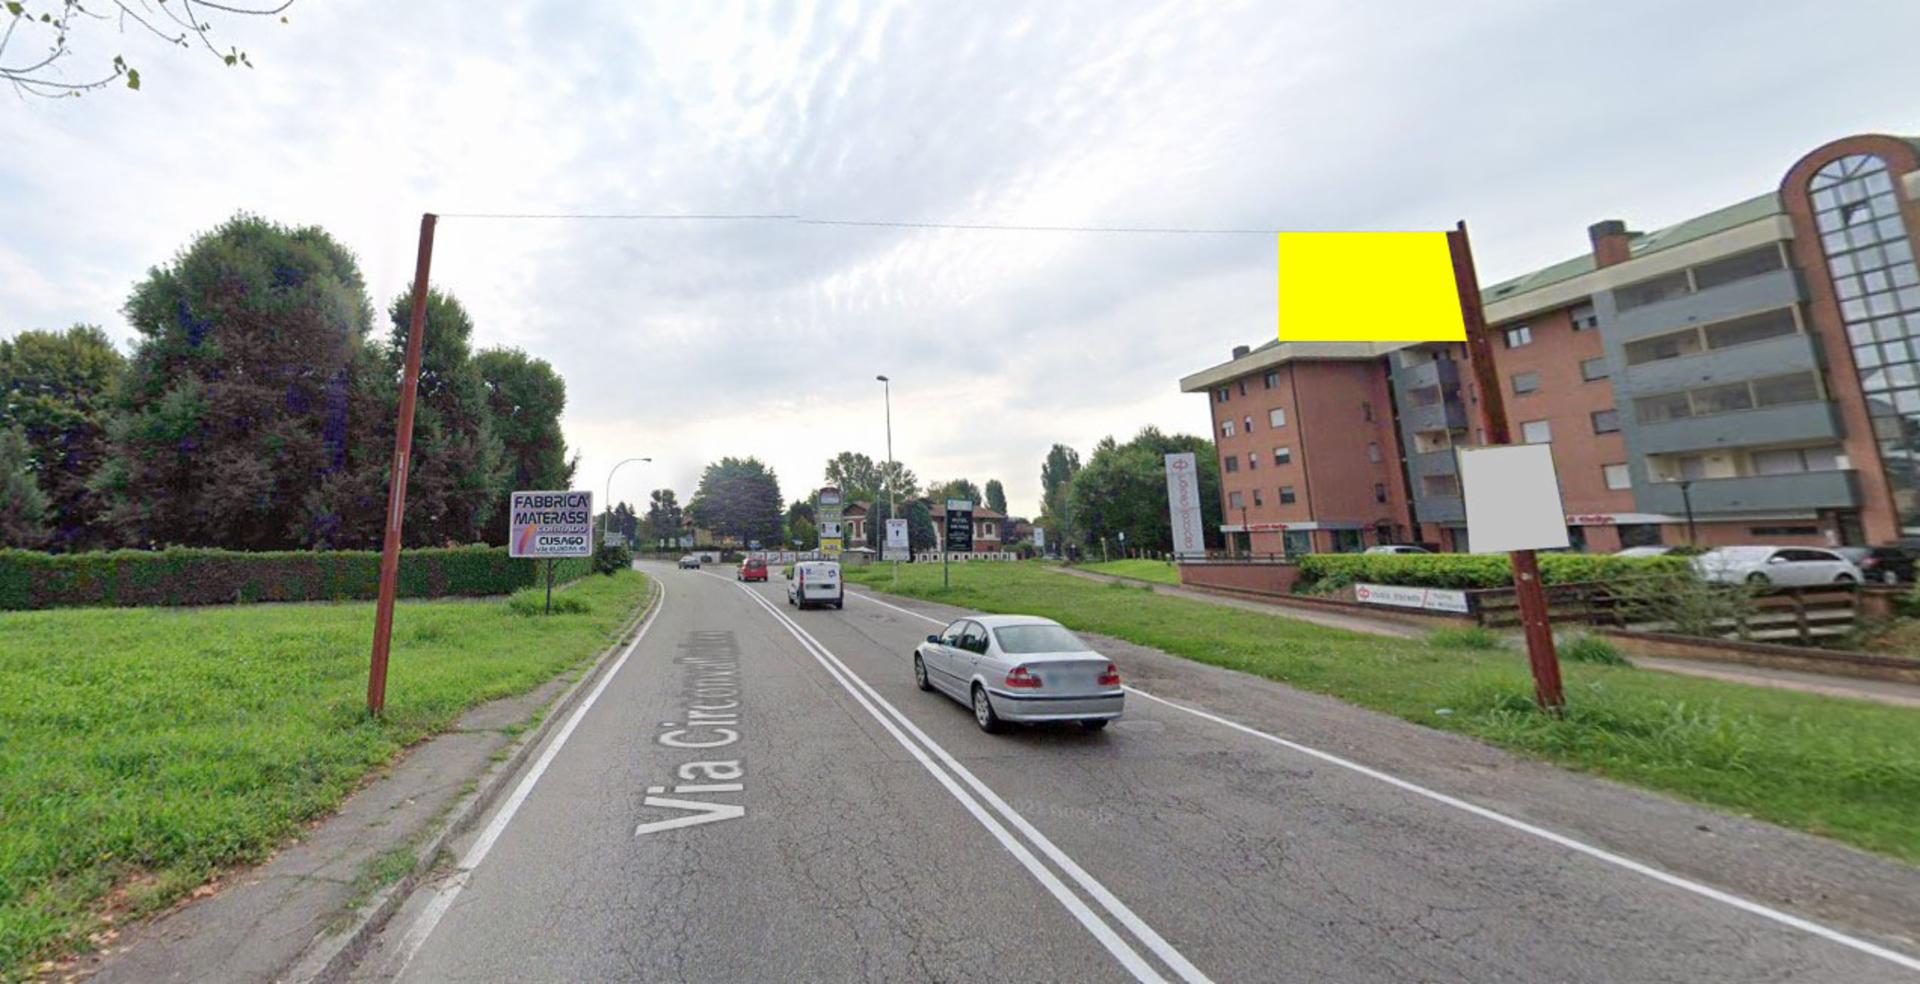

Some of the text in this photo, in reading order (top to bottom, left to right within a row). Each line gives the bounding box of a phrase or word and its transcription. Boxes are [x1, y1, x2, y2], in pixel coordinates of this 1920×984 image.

[514, 495, 587, 508] FABBRICA
[514, 512, 588, 525] MATERASSI
[539, 536, 584, 546] CUSAGO
